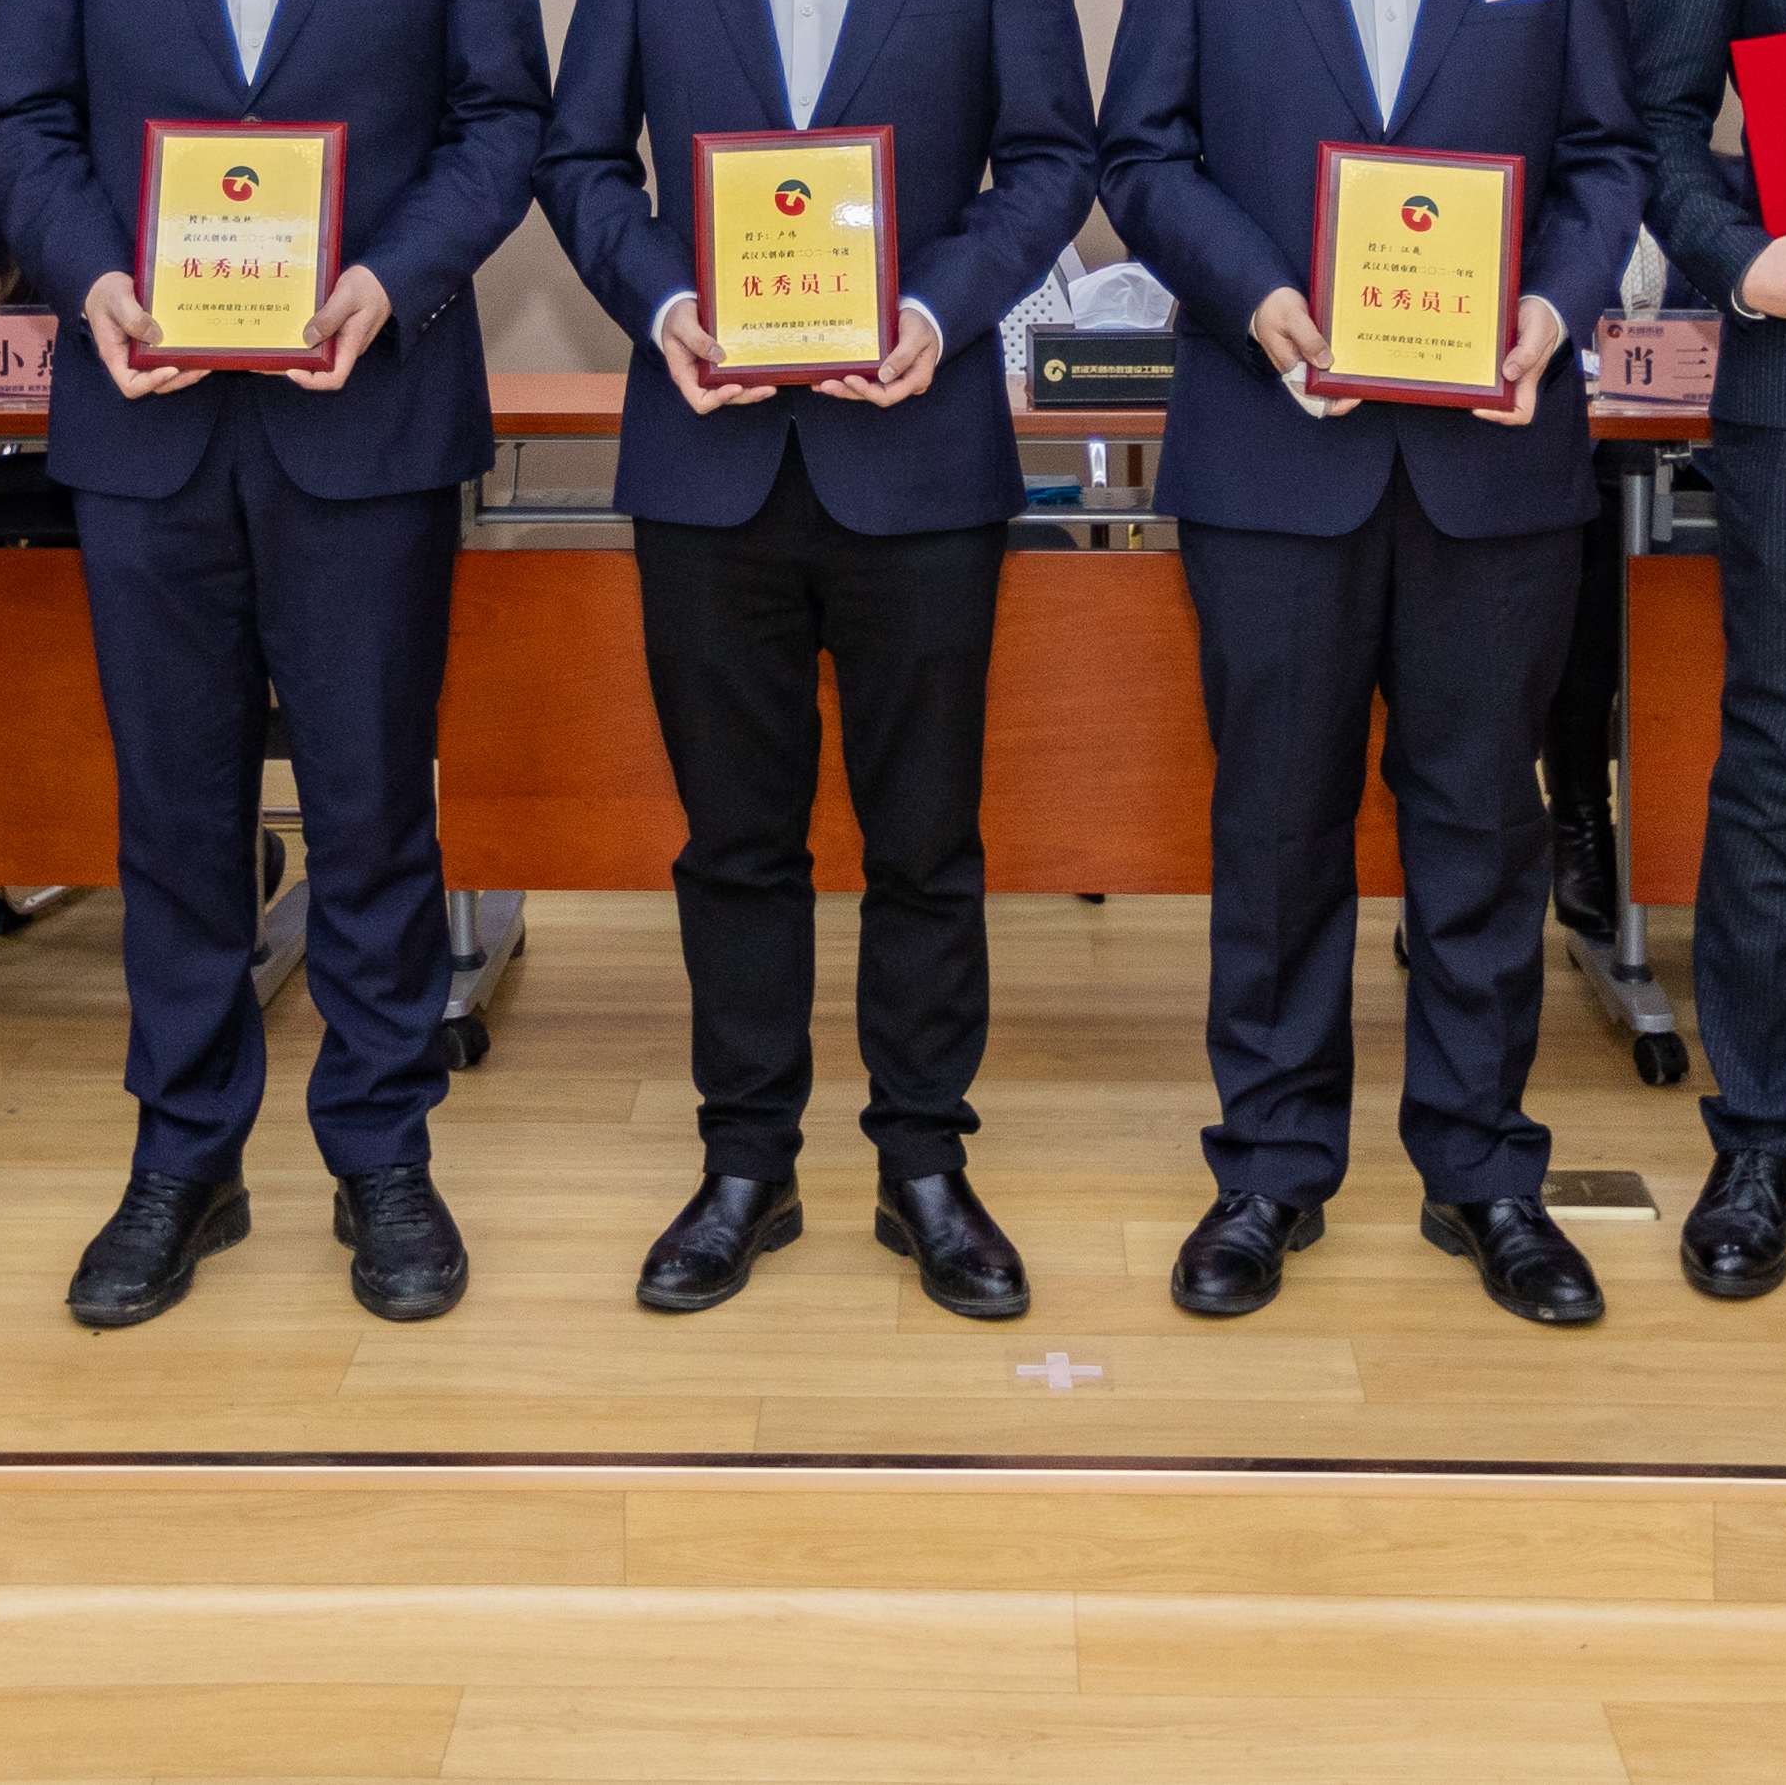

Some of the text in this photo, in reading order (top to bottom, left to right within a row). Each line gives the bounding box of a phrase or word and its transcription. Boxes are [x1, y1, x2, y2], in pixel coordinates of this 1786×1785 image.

[181, 257, 289, 280] 优秀员工
[741, 272, 850, 298] 优秀员工
[1360, 286, 1472, 315] 优秀员工
